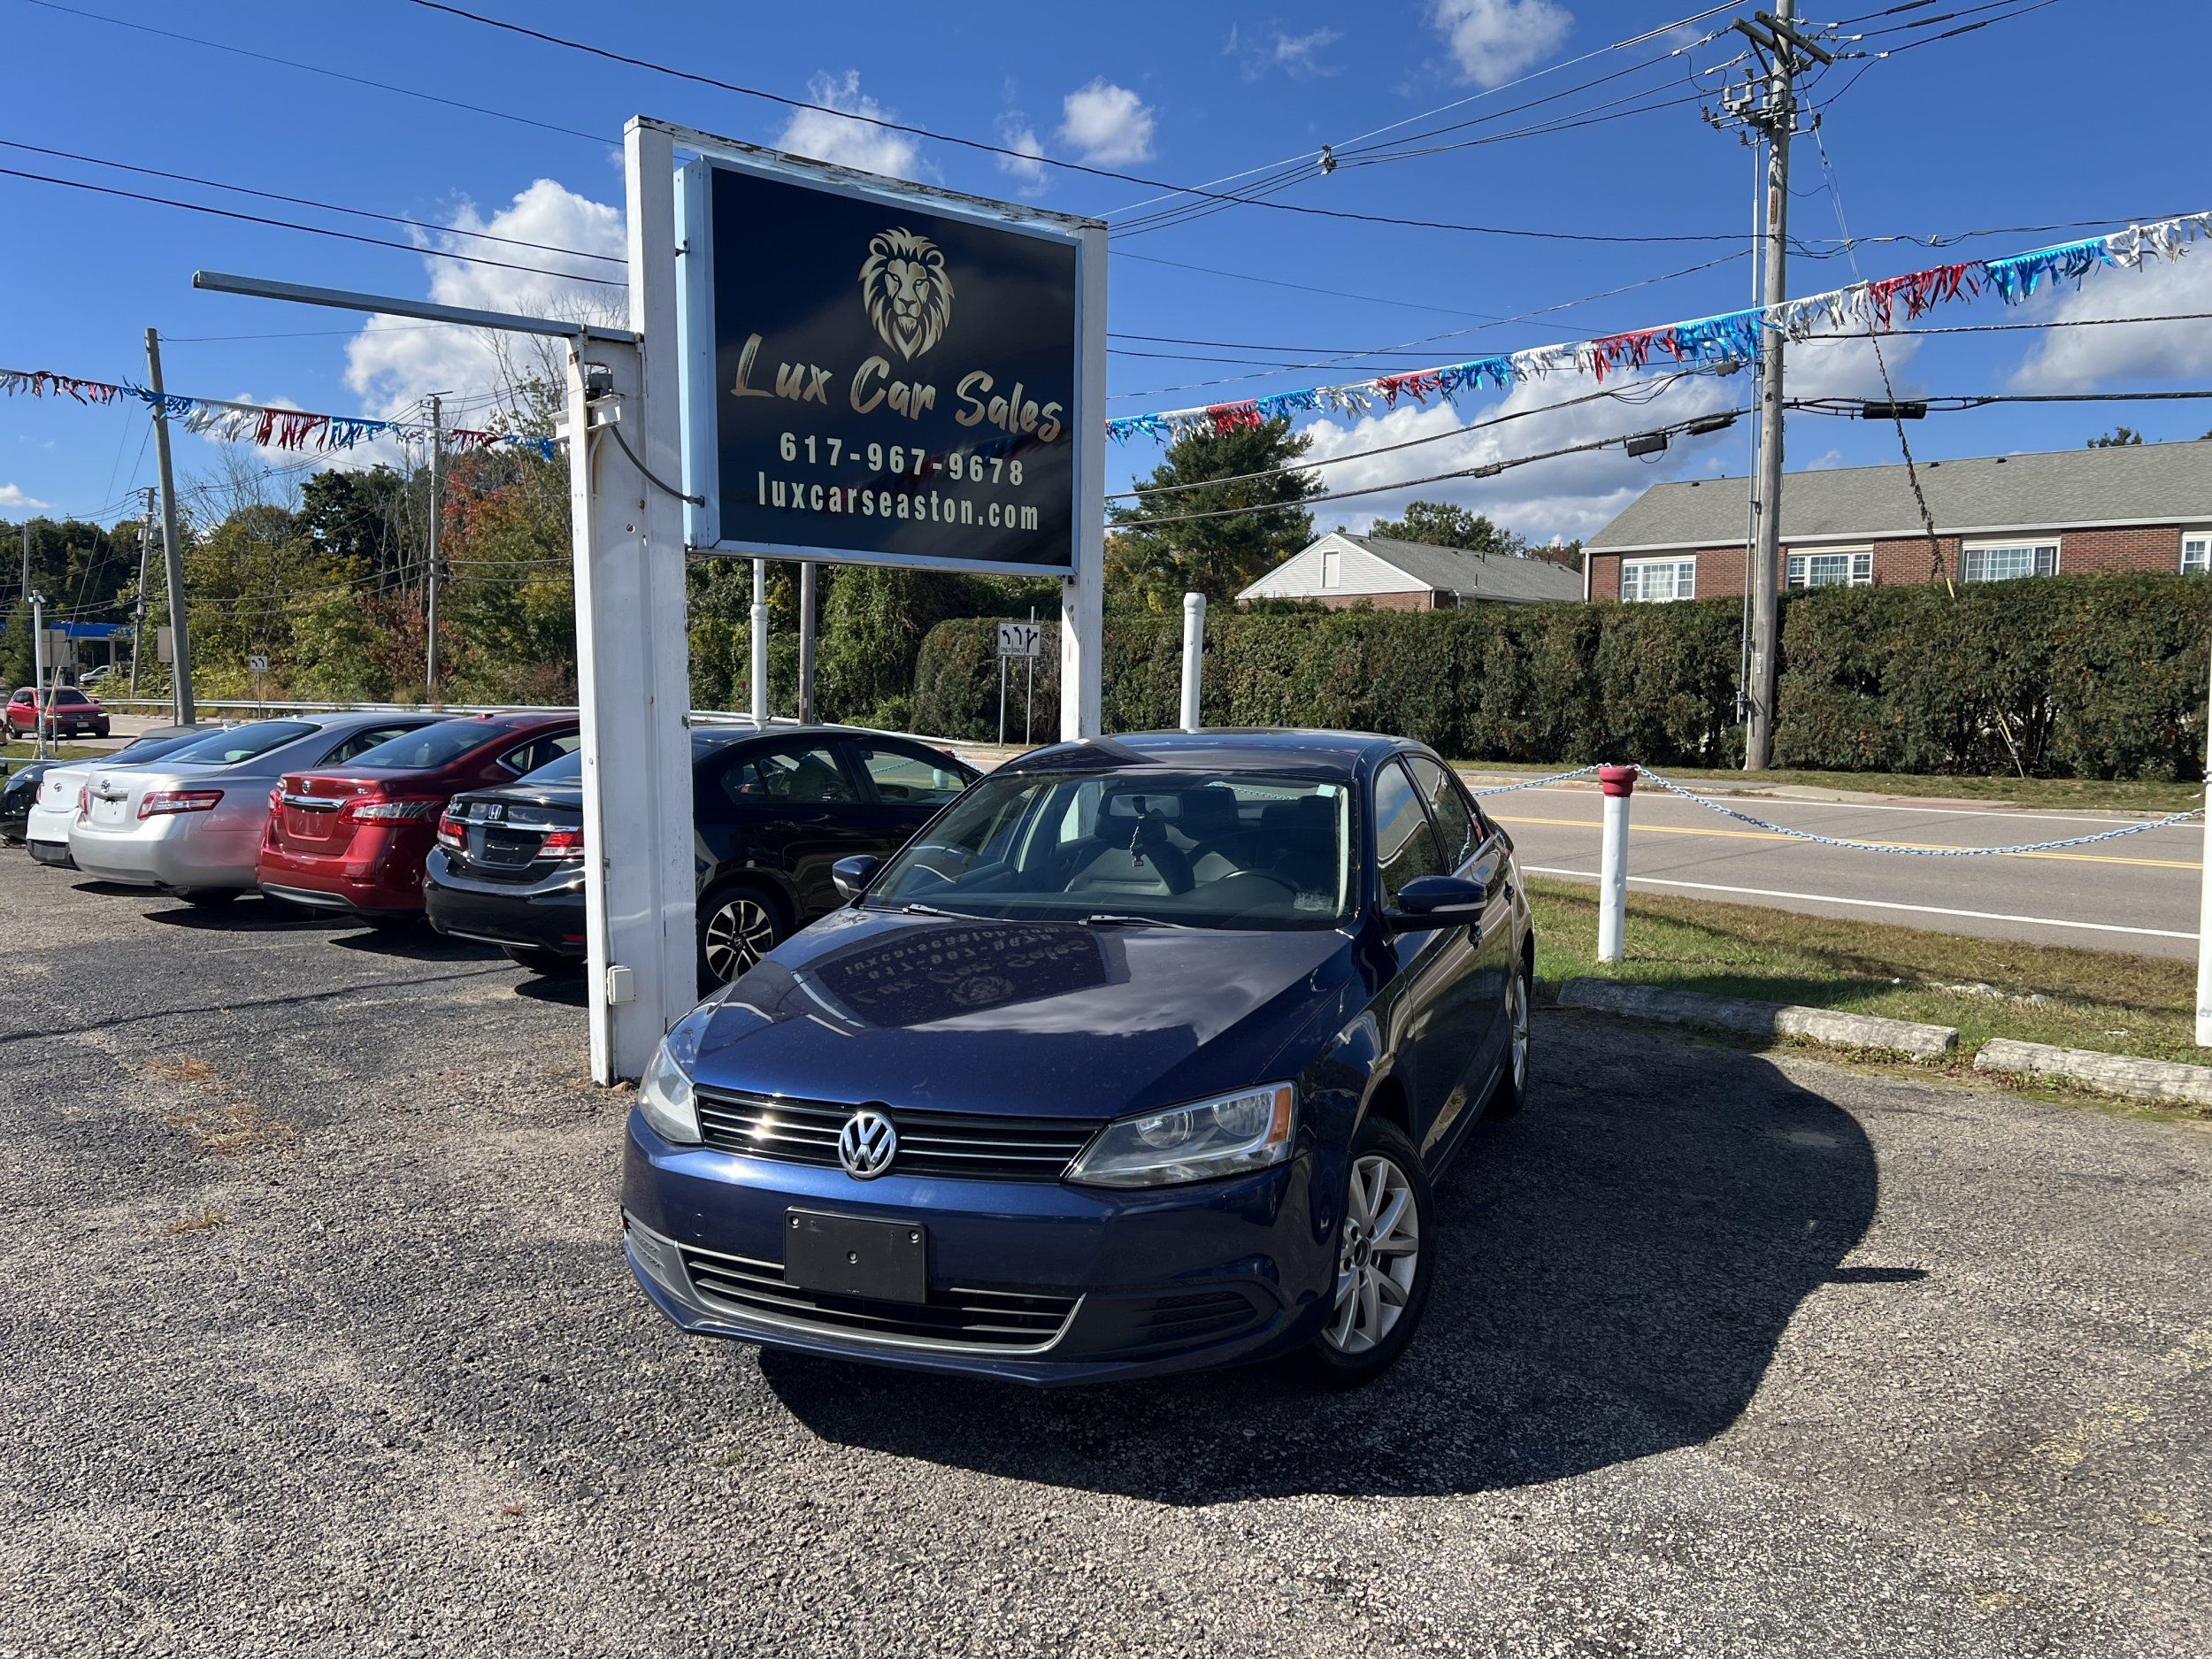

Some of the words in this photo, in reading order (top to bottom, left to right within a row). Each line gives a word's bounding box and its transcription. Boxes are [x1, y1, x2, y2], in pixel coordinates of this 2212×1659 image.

[730, 333, 833, 405] Lux
[849, 356, 937, 420] Car
[955, 370, 1064, 442] Sales
[780, 432, 1024, 486] 617-967-9678
[758, 471, 1039, 530] luxcarseaston.com
